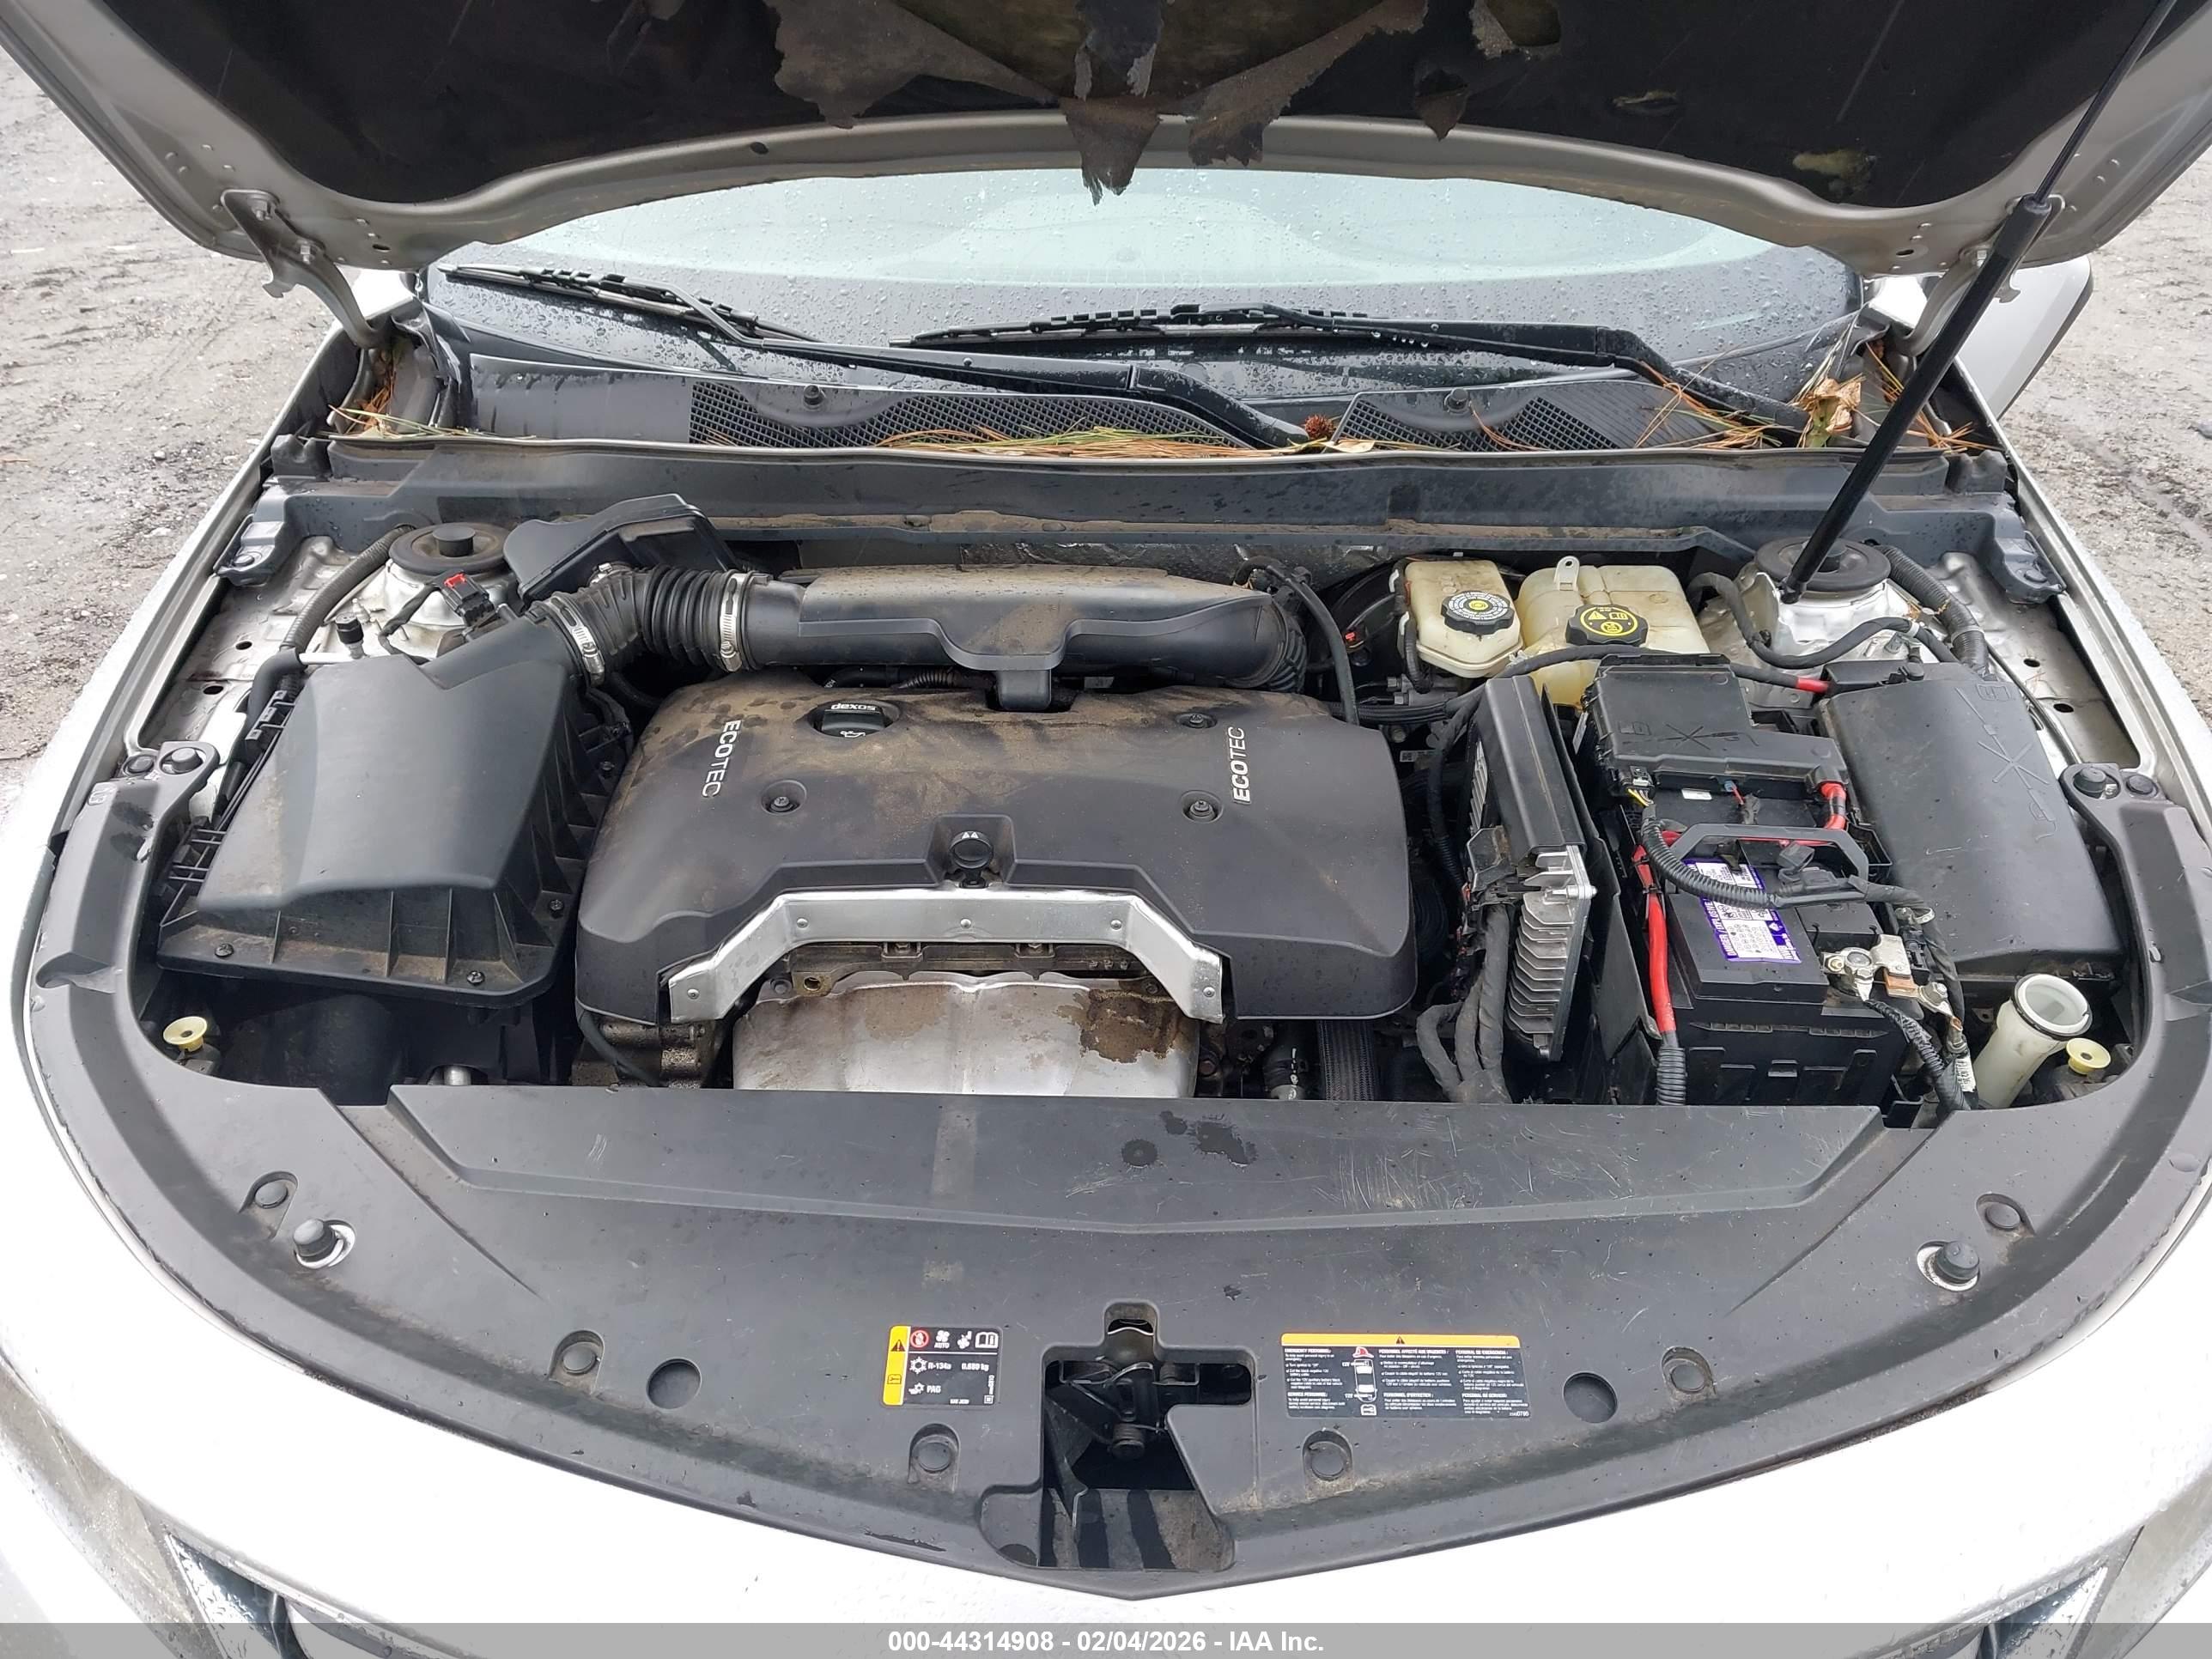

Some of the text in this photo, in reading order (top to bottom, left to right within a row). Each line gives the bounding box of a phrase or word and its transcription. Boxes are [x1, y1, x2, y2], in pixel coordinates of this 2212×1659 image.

[702, 720, 741, 798] ECOTEC
[1228, 726, 1251, 802] ECOTEC
[927, 1362, 951, 1370] R-134a
[927, 1385, 942, 1394] PAG
